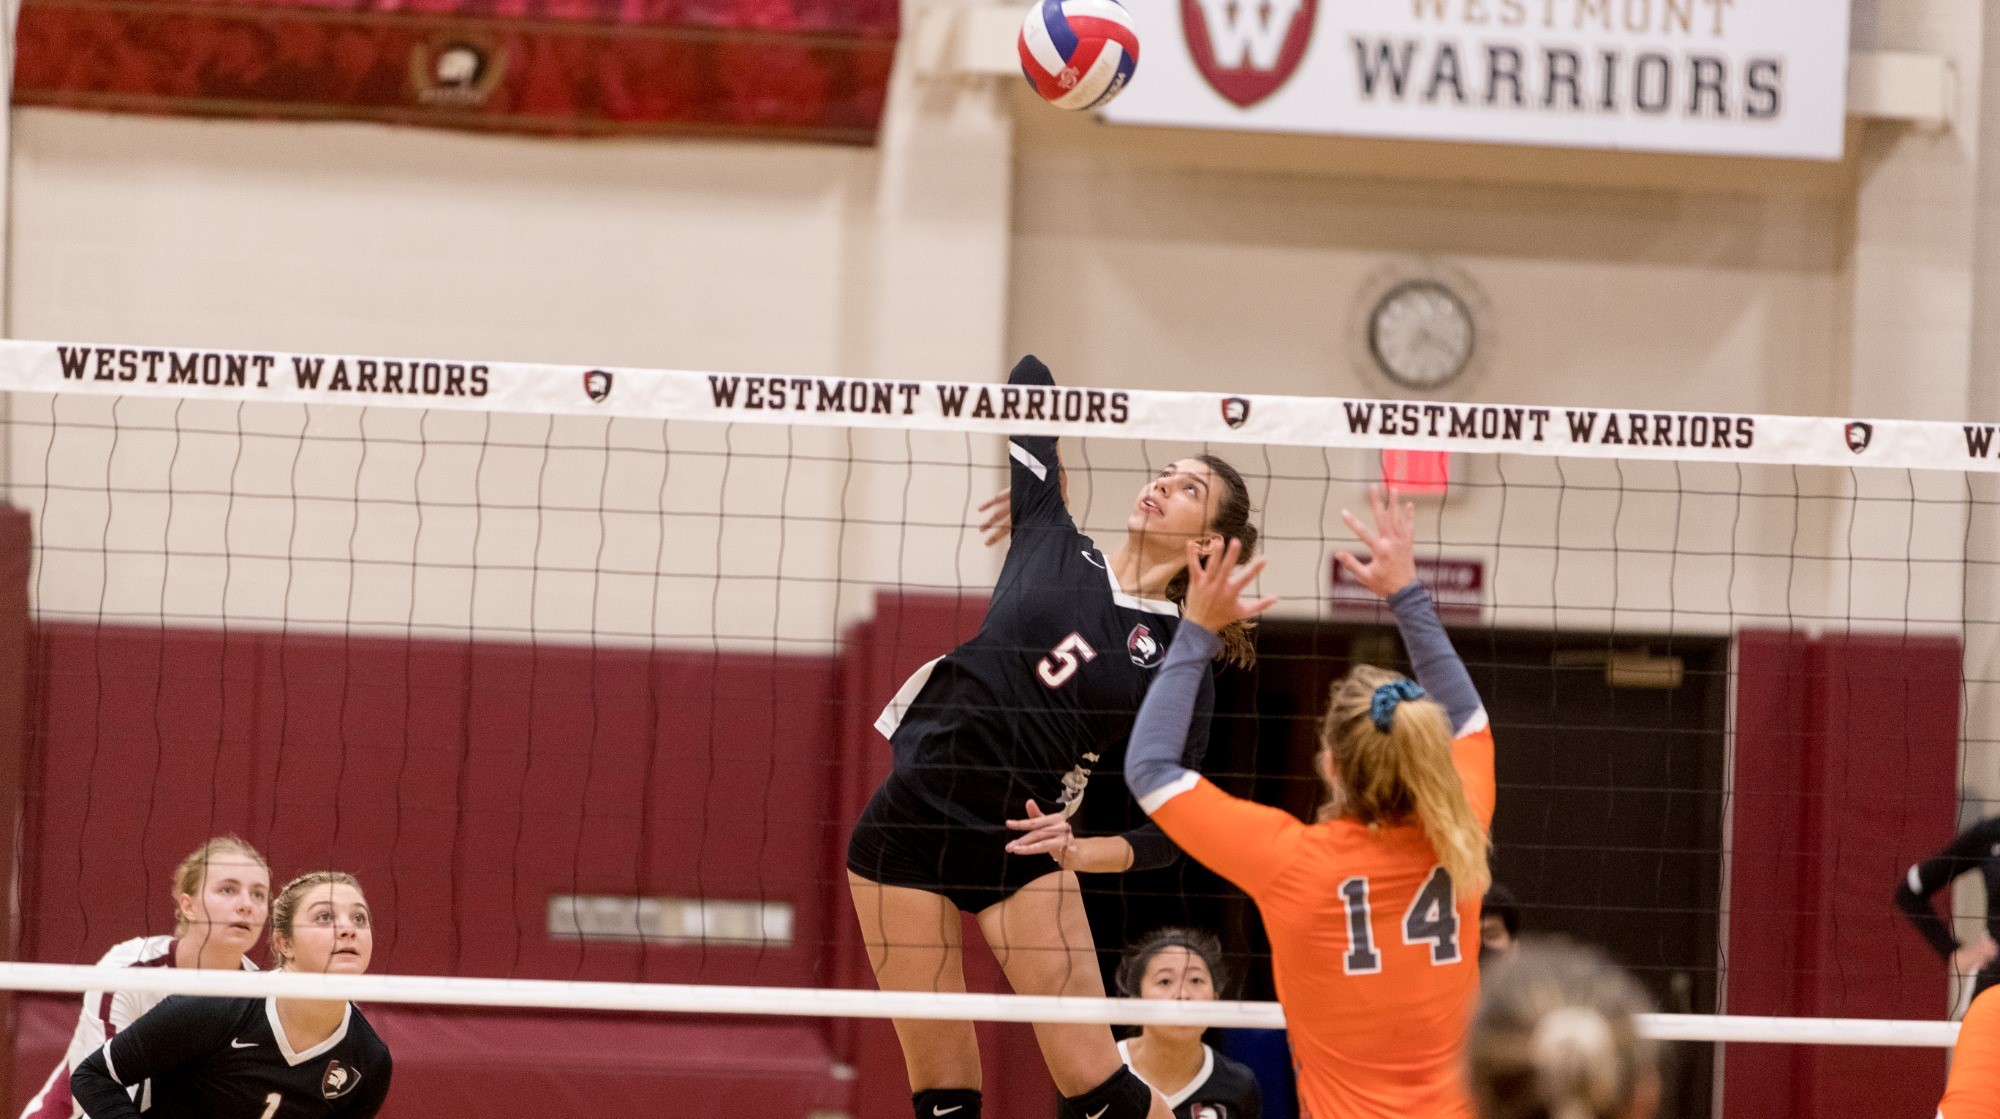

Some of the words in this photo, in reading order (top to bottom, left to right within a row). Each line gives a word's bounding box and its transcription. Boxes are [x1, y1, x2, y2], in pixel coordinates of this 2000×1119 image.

[1350, 37, 1782, 119] WARRIORS
[57, 346, 275, 388] WESTMONT
[292, 356, 490, 397] WARRIORS
[708, 374, 920, 415] WESTMONT
[936, 384, 1130, 424] WARRIORS
[1343, 402, 1550, 441] WESTMONT
[1566, 410, 1756, 449] WARRIORS
[1963, 426, 2000, 459] W
[1036, 631, 1098, 689] 5
[1338, 866, 1463, 976] 14
